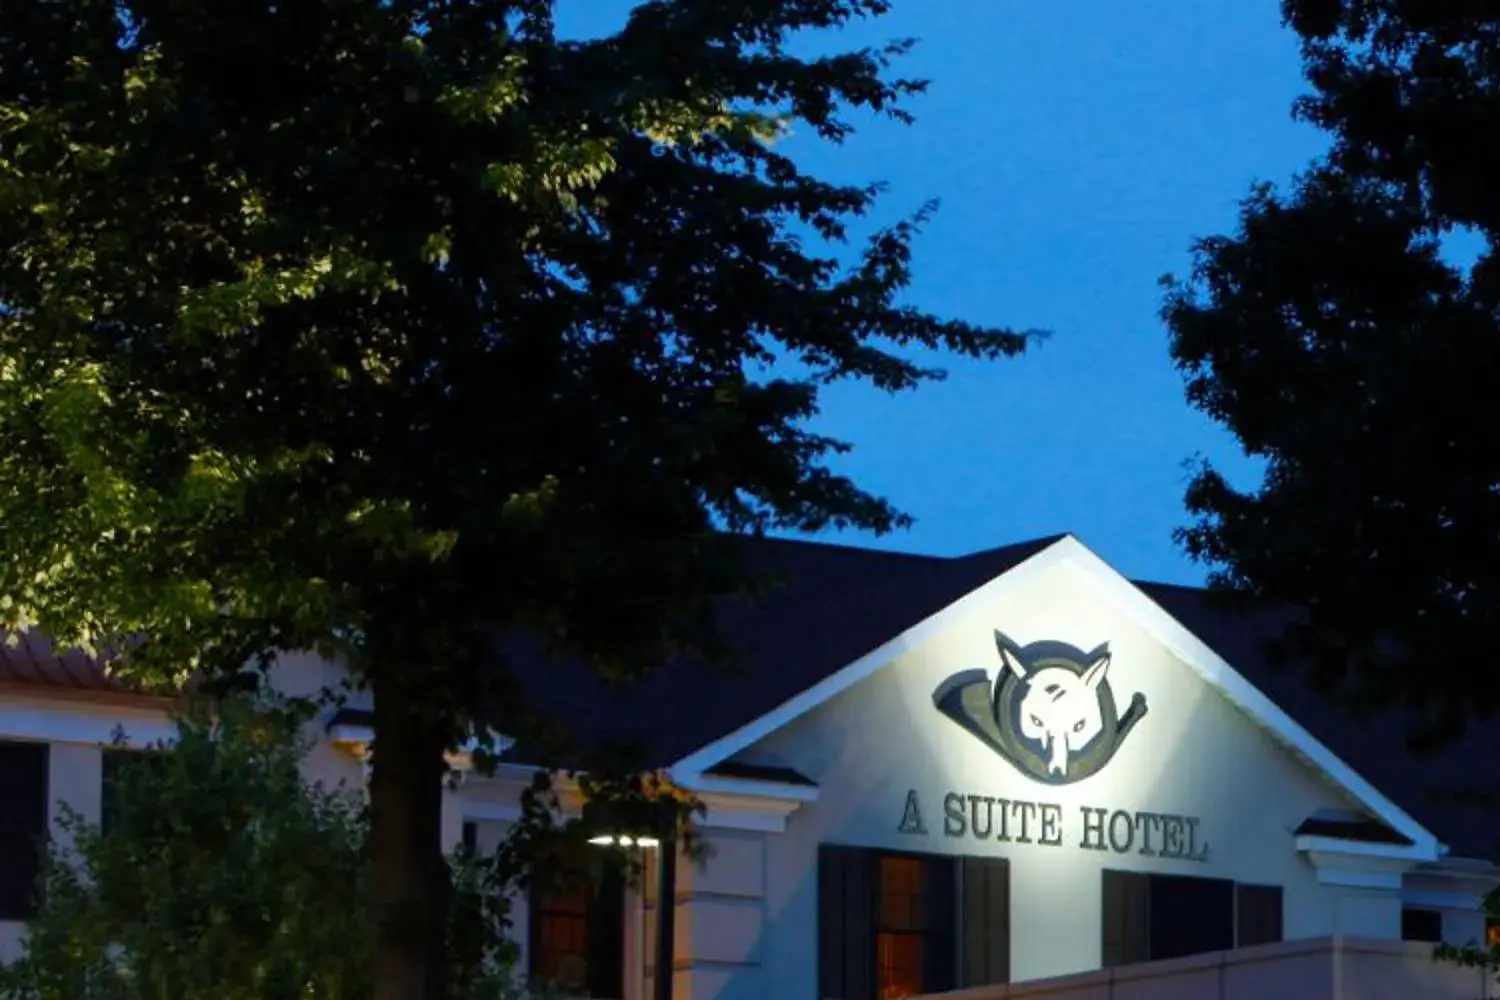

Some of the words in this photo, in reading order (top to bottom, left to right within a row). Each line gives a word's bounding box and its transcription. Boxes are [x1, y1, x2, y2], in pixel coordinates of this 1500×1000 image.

[898, 789, 928, 835] A
[943, 791, 1063, 847] SUITE
[1079, 806, 1210, 862] HOTEL
